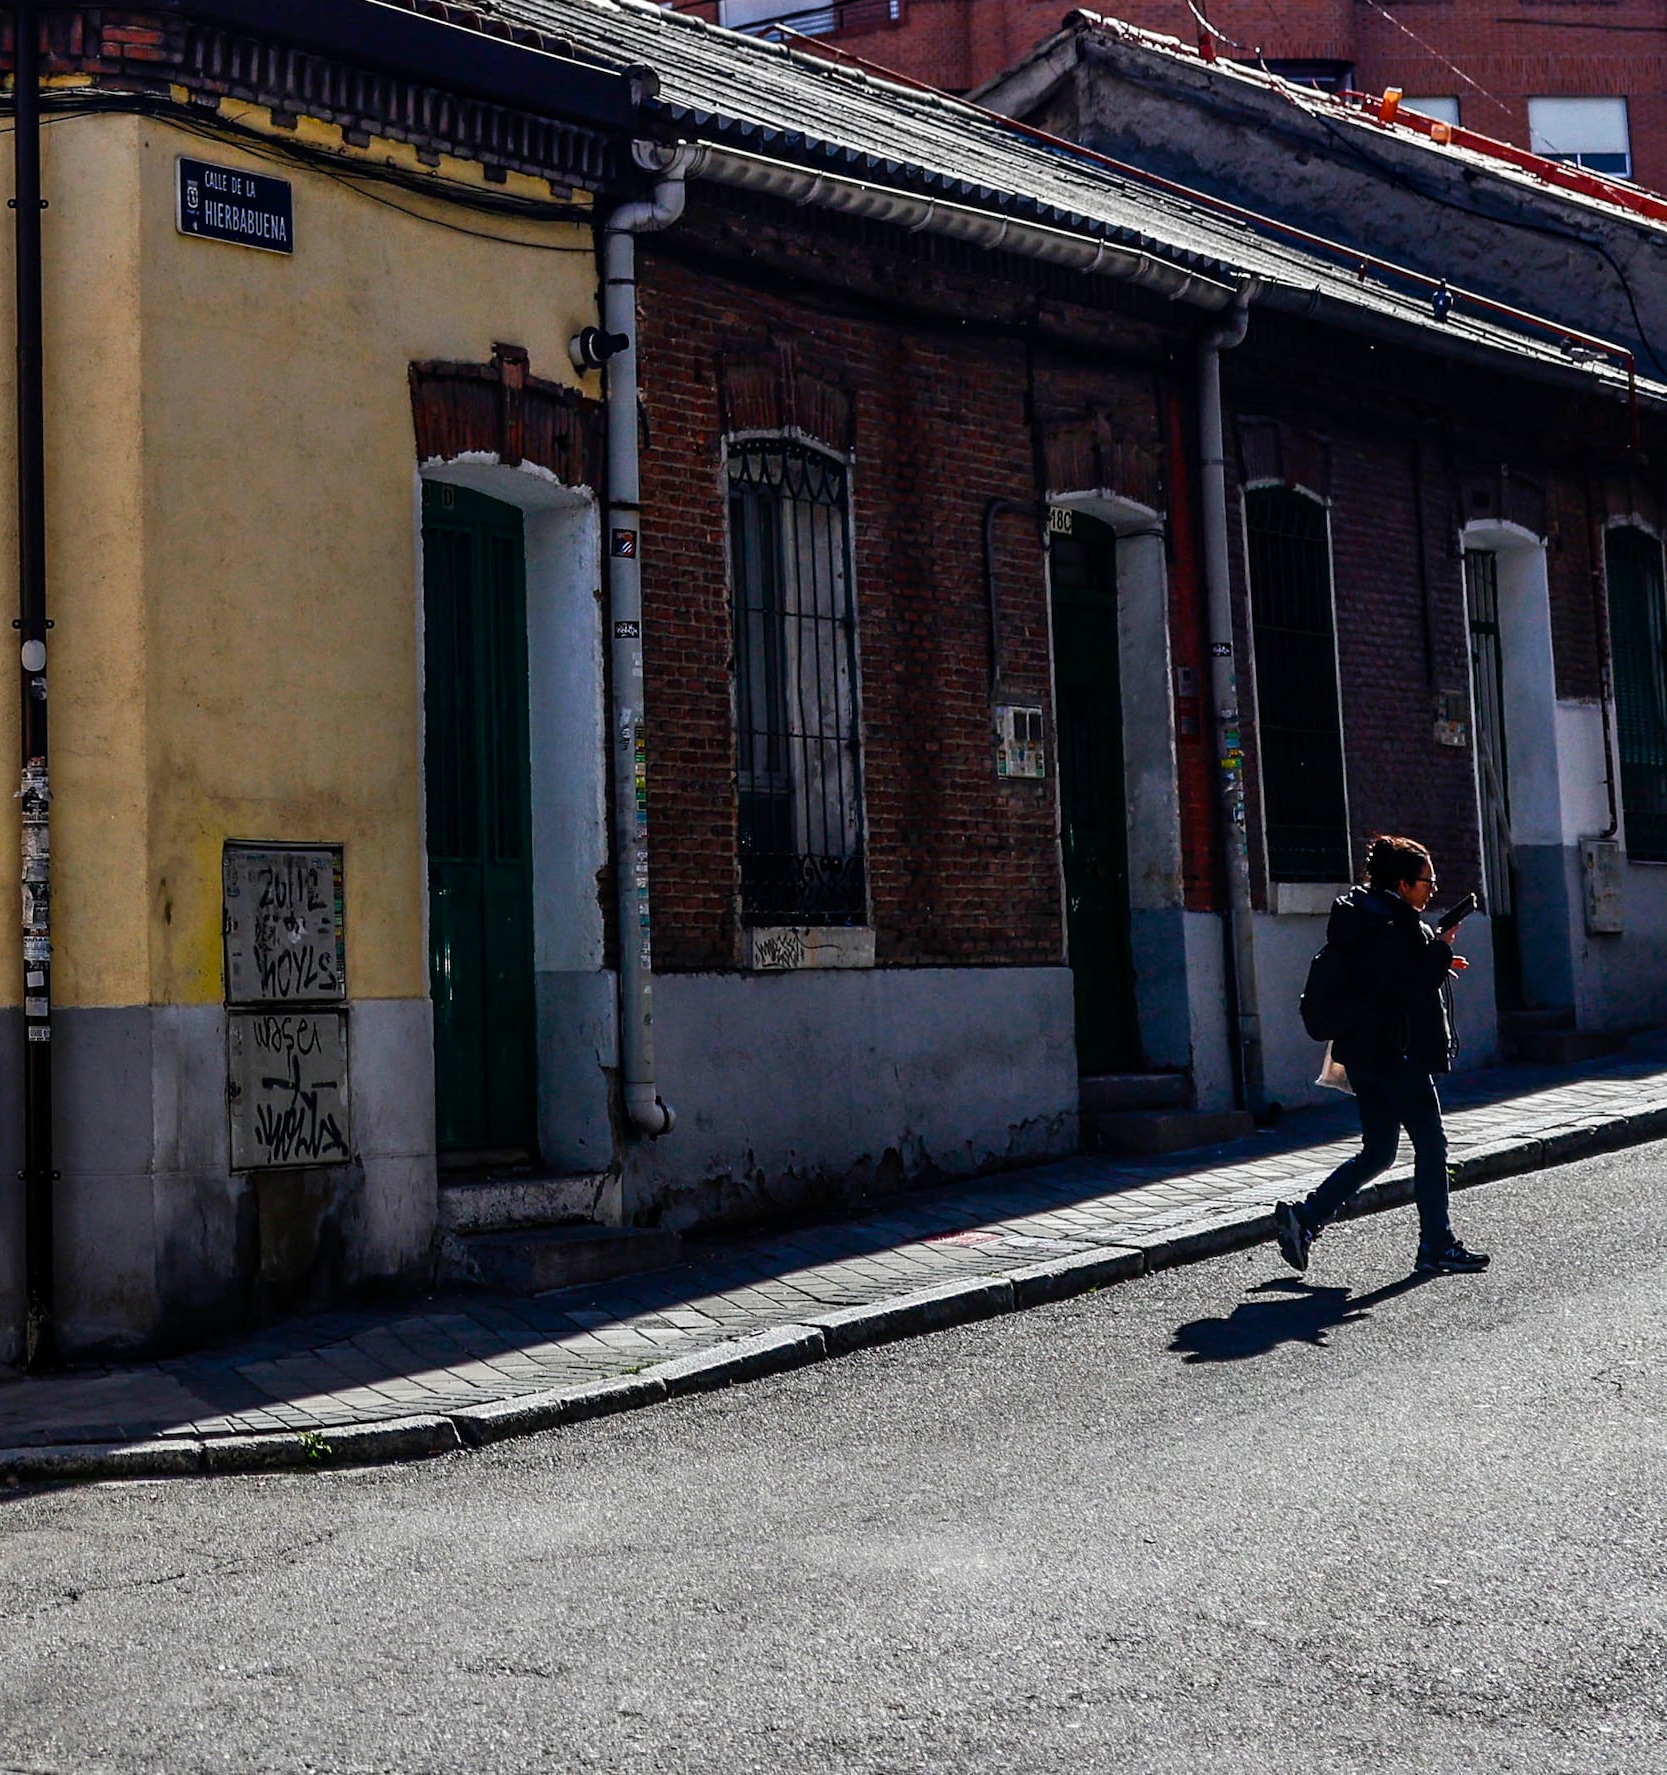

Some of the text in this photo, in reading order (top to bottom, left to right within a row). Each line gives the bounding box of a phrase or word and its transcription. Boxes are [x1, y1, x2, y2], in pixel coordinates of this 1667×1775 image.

[204, 170, 257, 198] CALLE DE LA
[204, 199, 287, 242] HIERBABUENA
[1051, 509, 1072, 531] 18C
